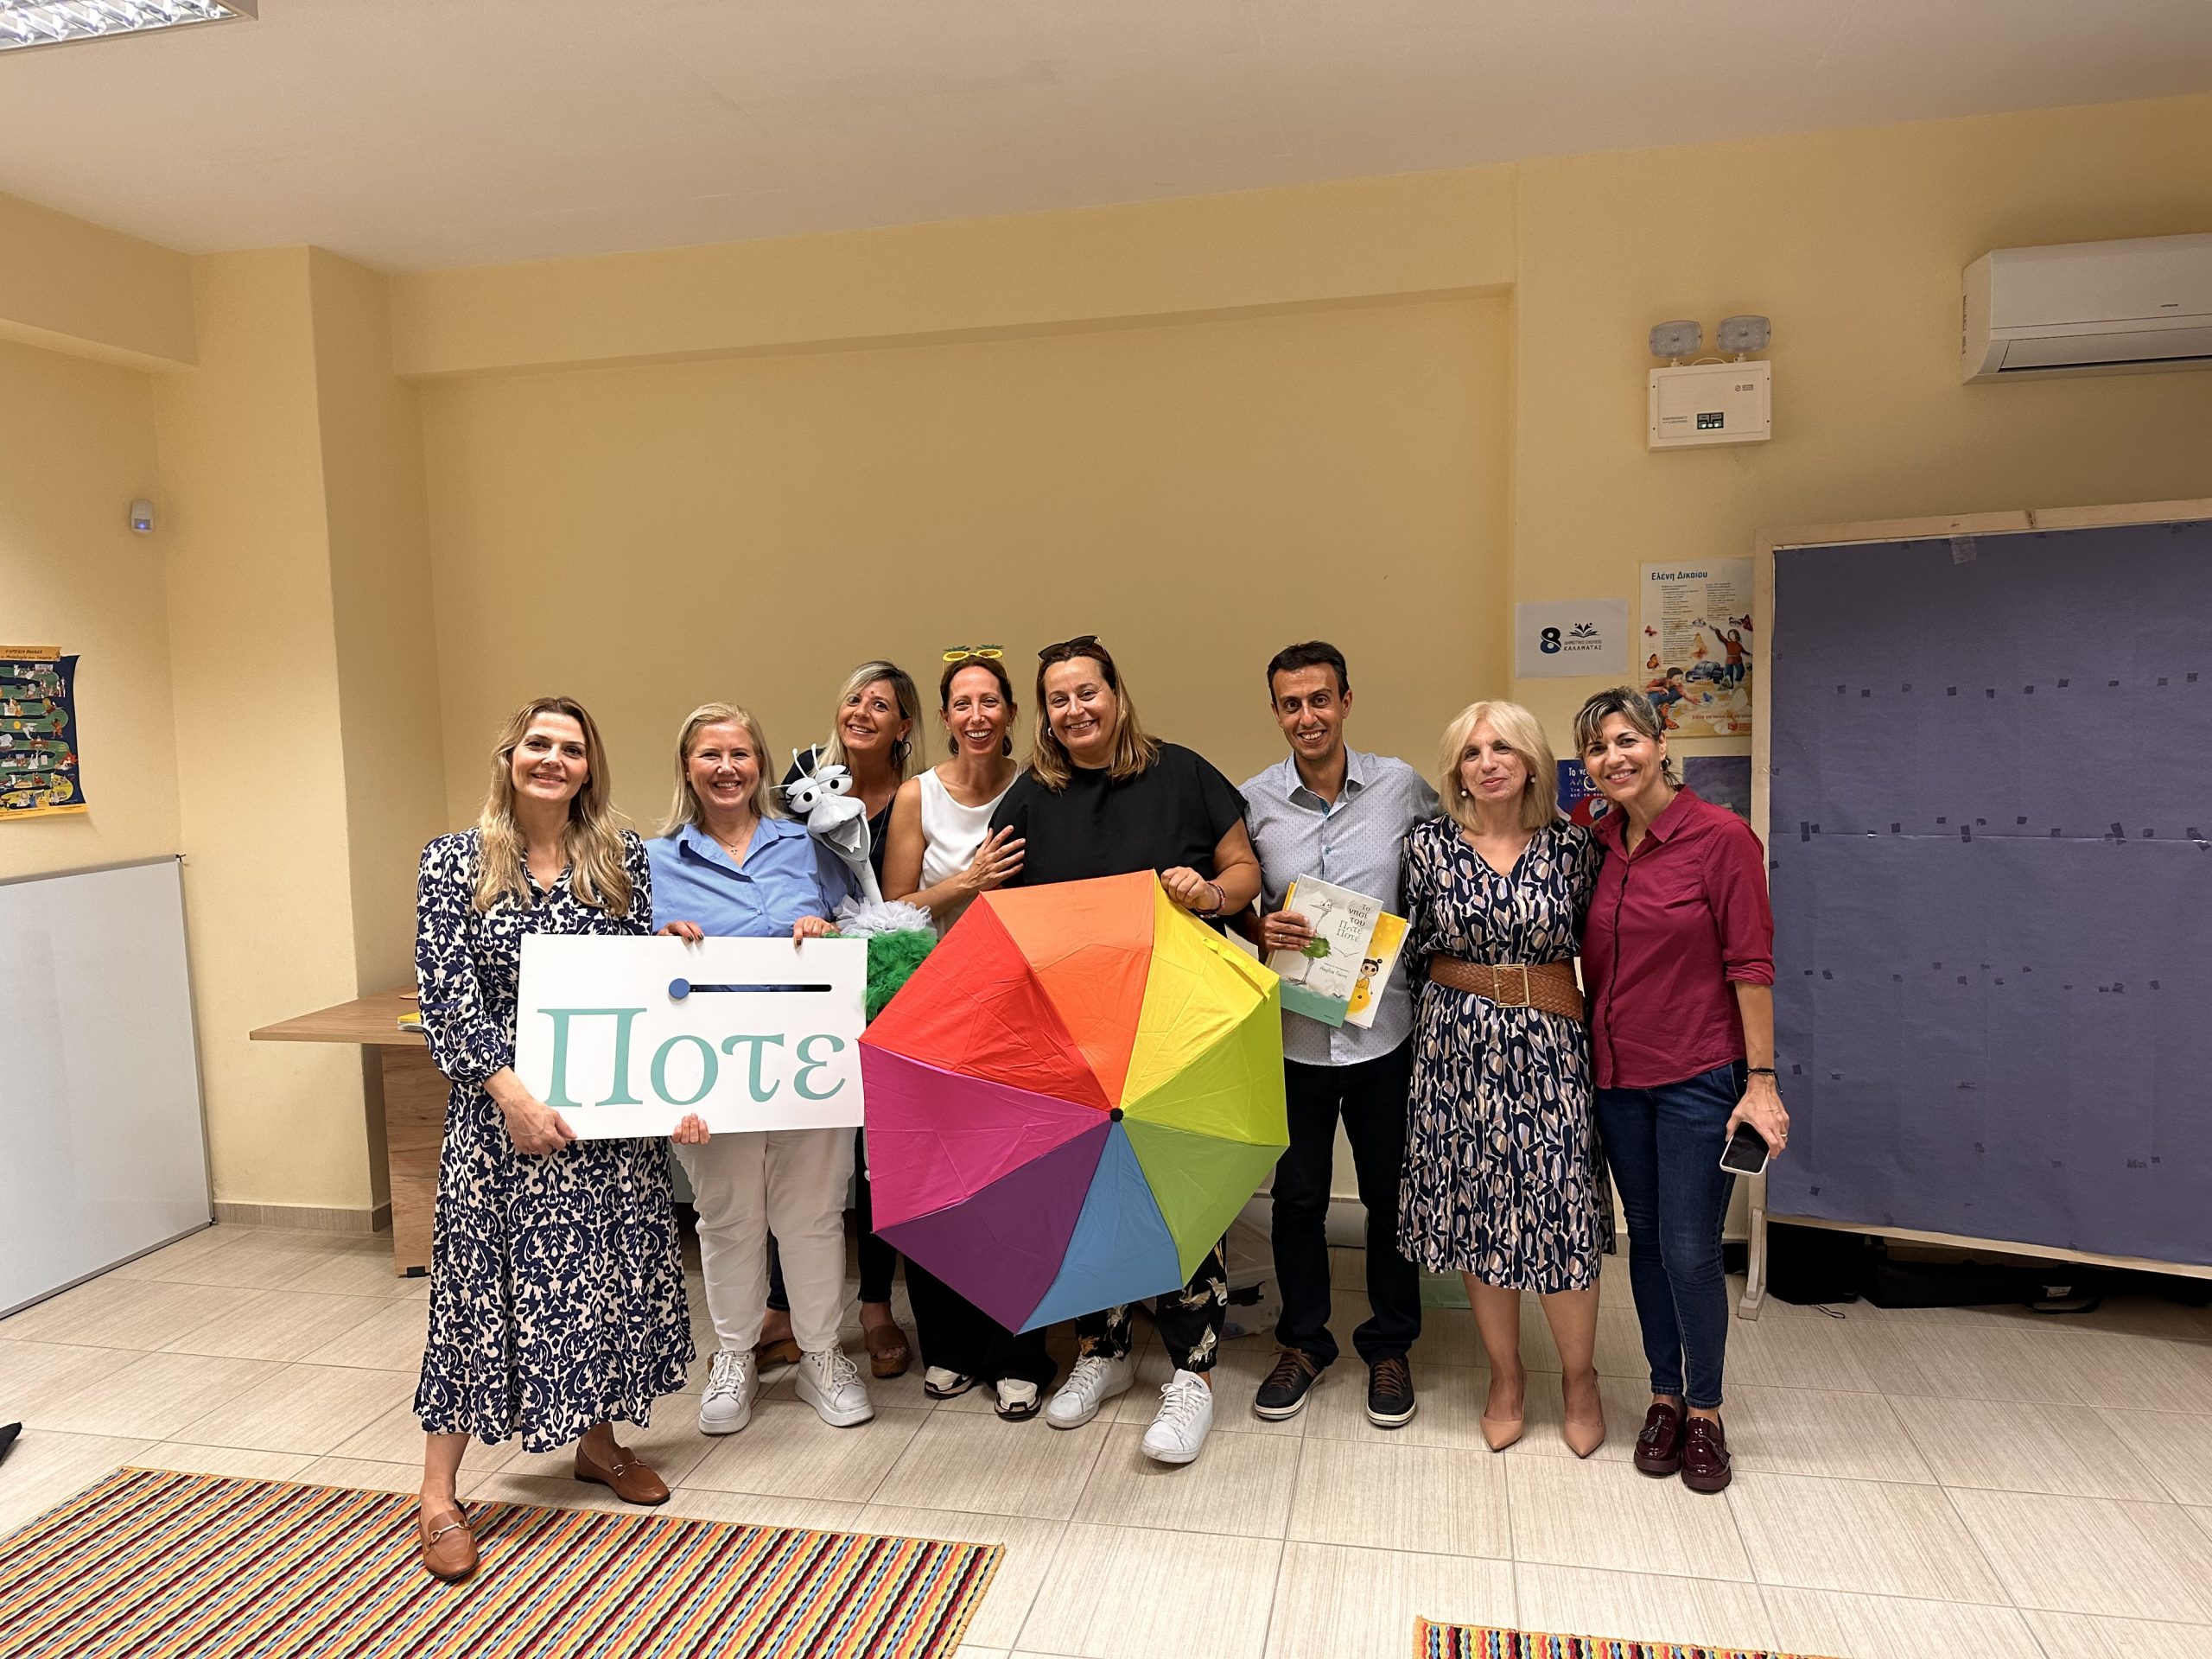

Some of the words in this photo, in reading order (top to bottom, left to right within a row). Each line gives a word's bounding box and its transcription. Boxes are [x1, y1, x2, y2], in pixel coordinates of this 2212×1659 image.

[1651, 571, 1675, 581] Ελένη
[1677, 570, 1708, 580] Δικαίου
[1540, 626, 1561, 654] 8
[1349, 908, 1369, 919] νησί
[1350, 917, 1366, 926] του
[1336, 928, 1361, 942] Ποτέ
[537, 1007, 846, 1108] Ποτε
